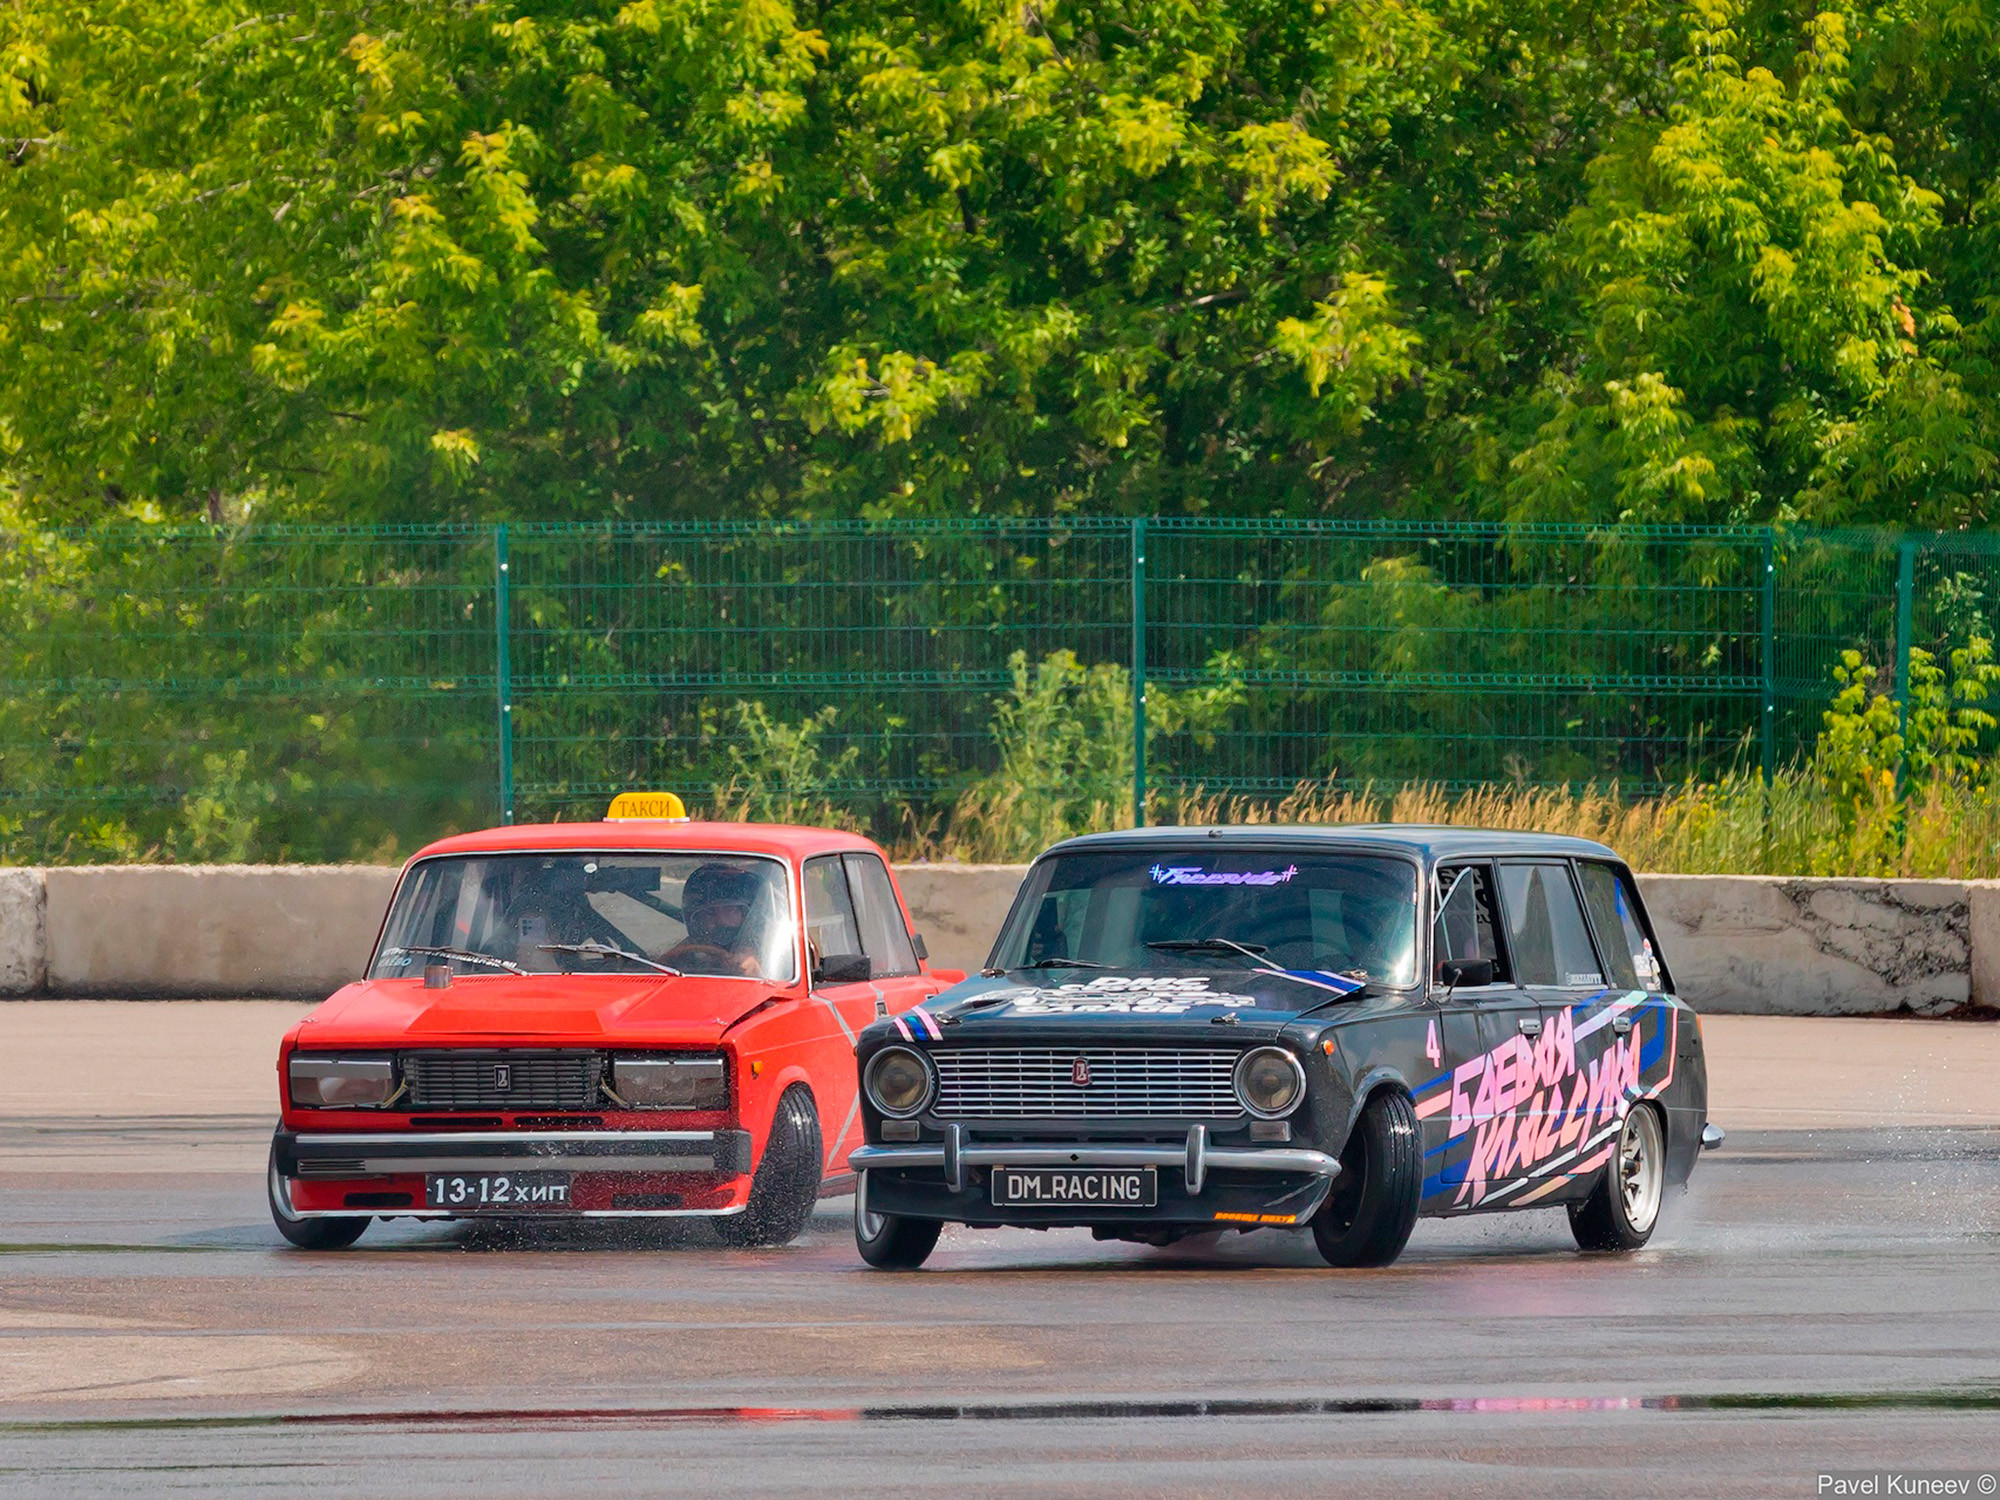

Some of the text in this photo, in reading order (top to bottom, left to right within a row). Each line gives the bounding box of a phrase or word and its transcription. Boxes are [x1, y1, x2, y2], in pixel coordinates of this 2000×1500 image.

[618, 800, 670, 817] ТАКСИ
[1426, 1019, 1441, 1069] 4
[1007, 1175, 1141, 1200] DM_RACING
